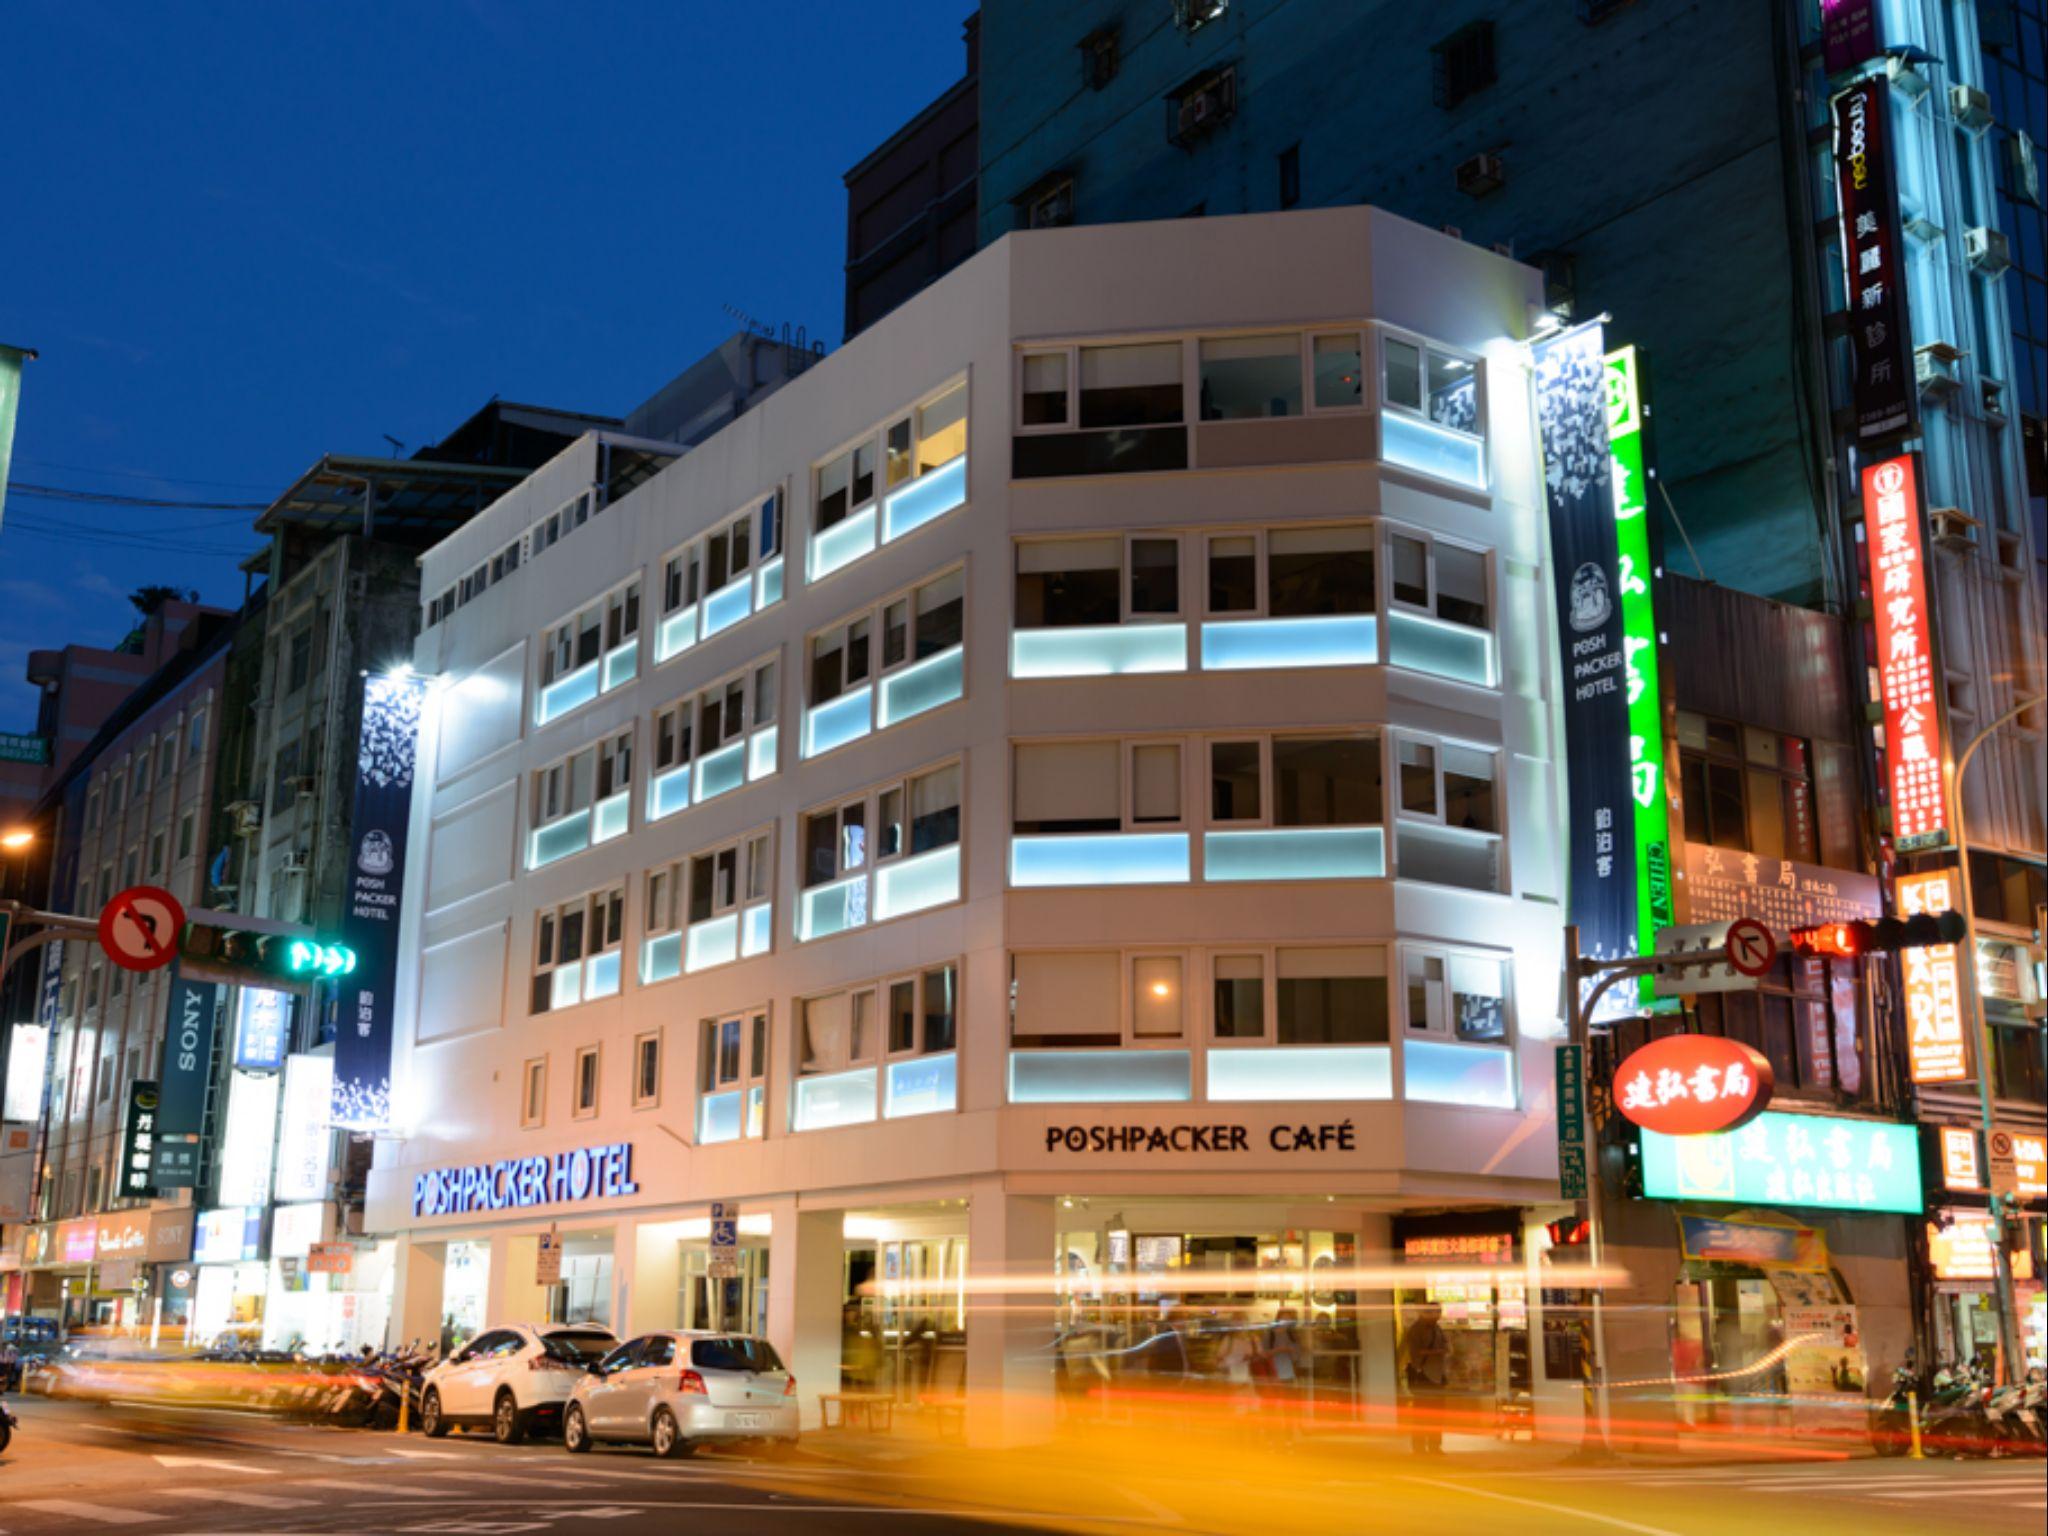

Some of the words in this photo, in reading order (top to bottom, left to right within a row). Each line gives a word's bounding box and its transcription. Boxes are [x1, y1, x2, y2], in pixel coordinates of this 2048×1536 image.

[1572, 633, 1607, 657] POSH
[1573, 651, 1624, 680] PACKER
[1576, 676, 1618, 702] HOTEL
[356, 876, 386, 890] POSH
[354, 890, 397, 906] PACKER
[352, 906, 389, 920] HOTEL
[177, 987, 203, 1072] SONY
[1622, 1060, 1751, 1109] 建弘書局
[1045, 1124, 1250, 1153] POSHPACKER
[1268, 1118, 1356, 1152] CAFÉ
[1737, 1115, 1896, 1172] 建弘書局
[412, 1154, 551, 1218] POSHPACKER
[551, 1142, 640, 1203] HOTEL
